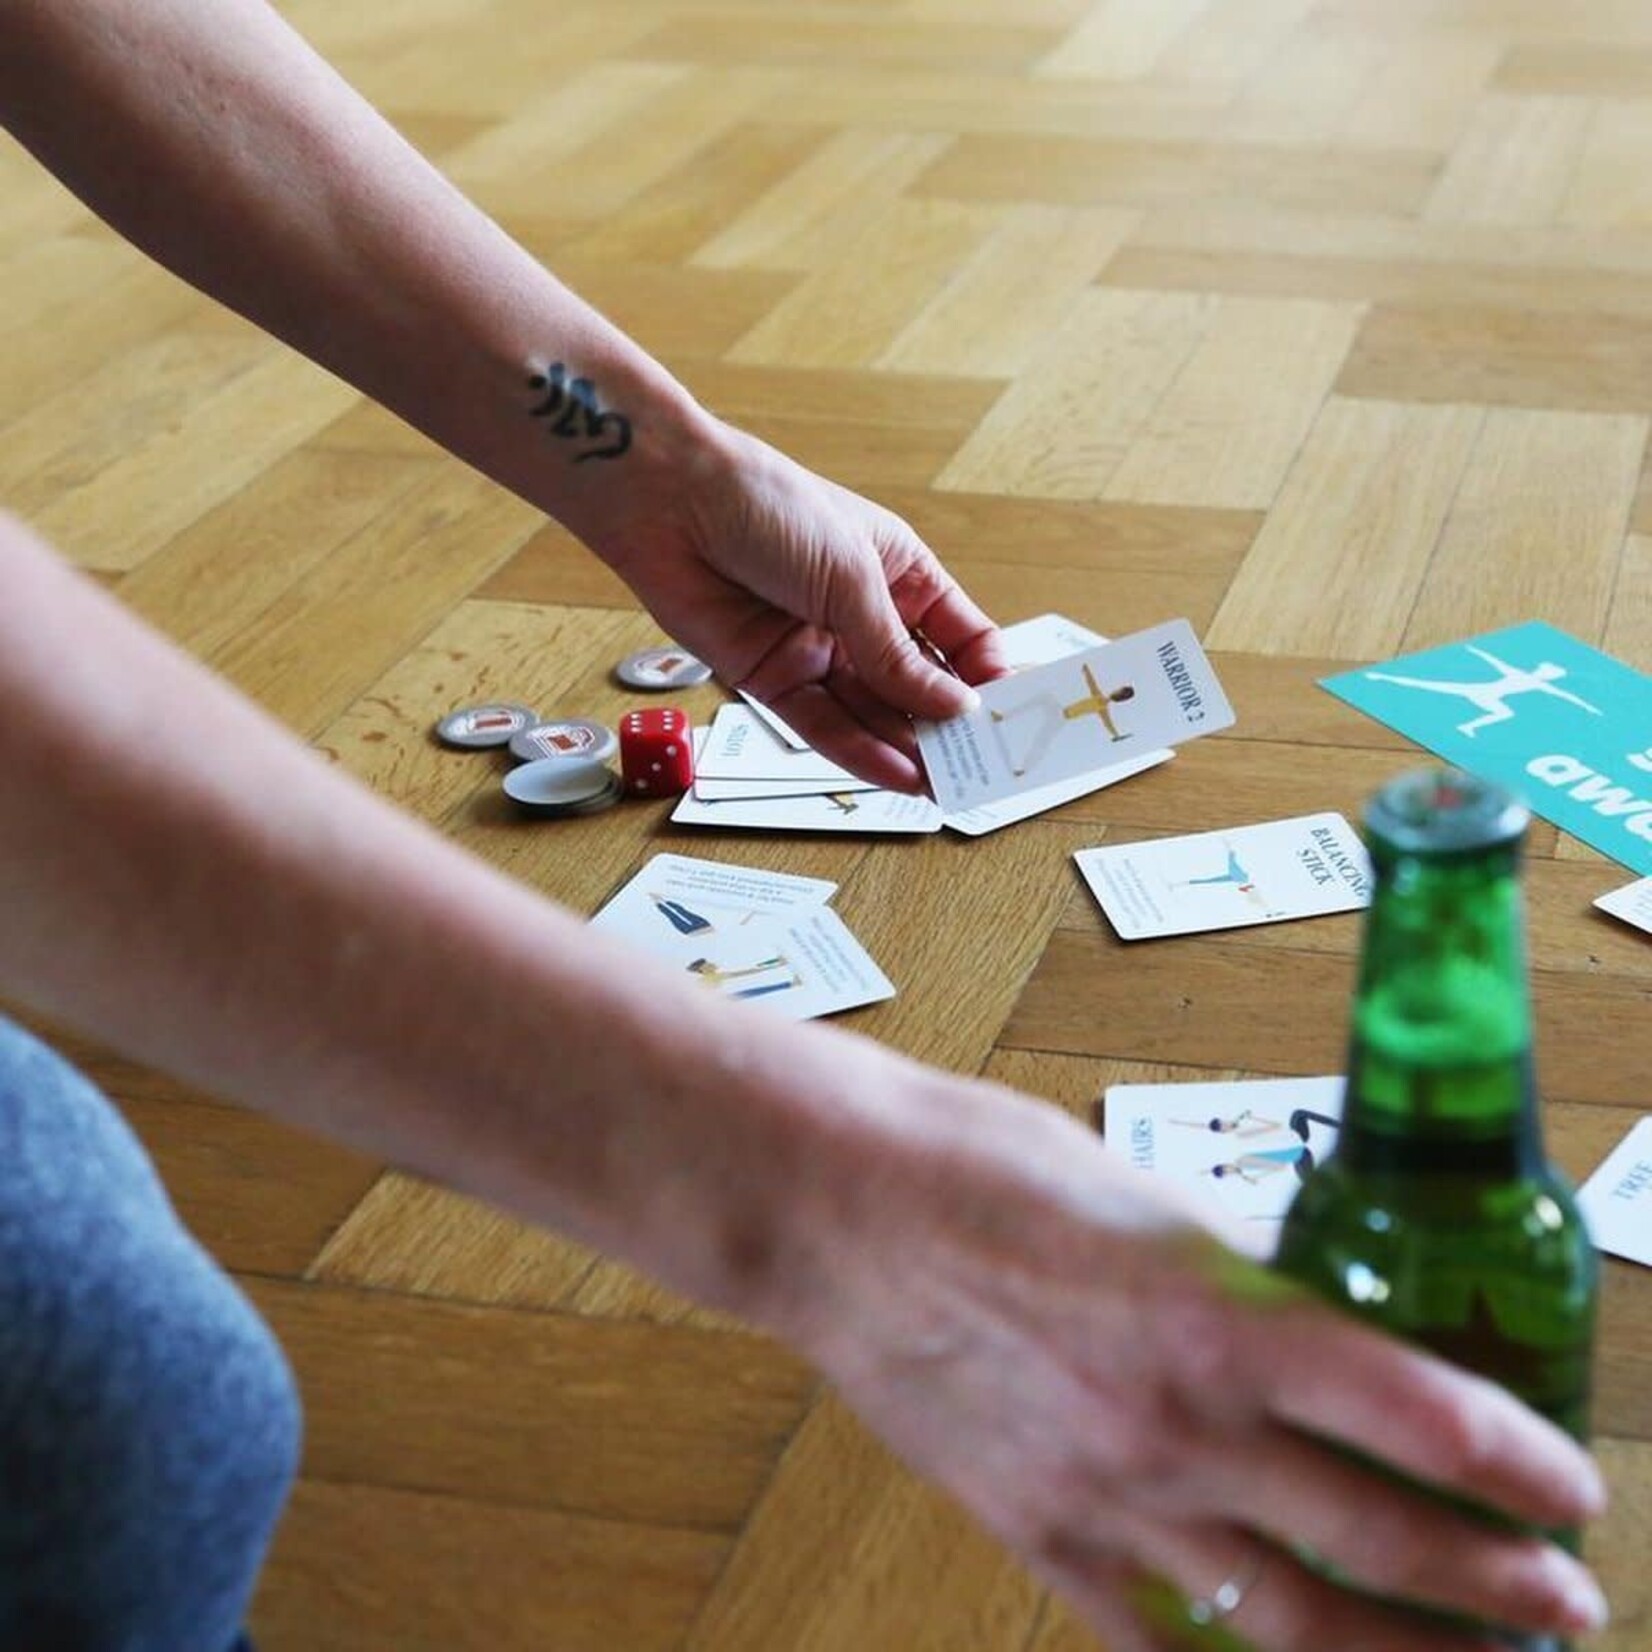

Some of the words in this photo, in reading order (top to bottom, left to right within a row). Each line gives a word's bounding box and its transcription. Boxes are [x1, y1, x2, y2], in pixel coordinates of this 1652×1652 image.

[1157, 641, 1202, 711] WARRIOR
[1296, 849, 1335, 885] STICK
[1131, 1116, 1155, 1170] HAIRS
